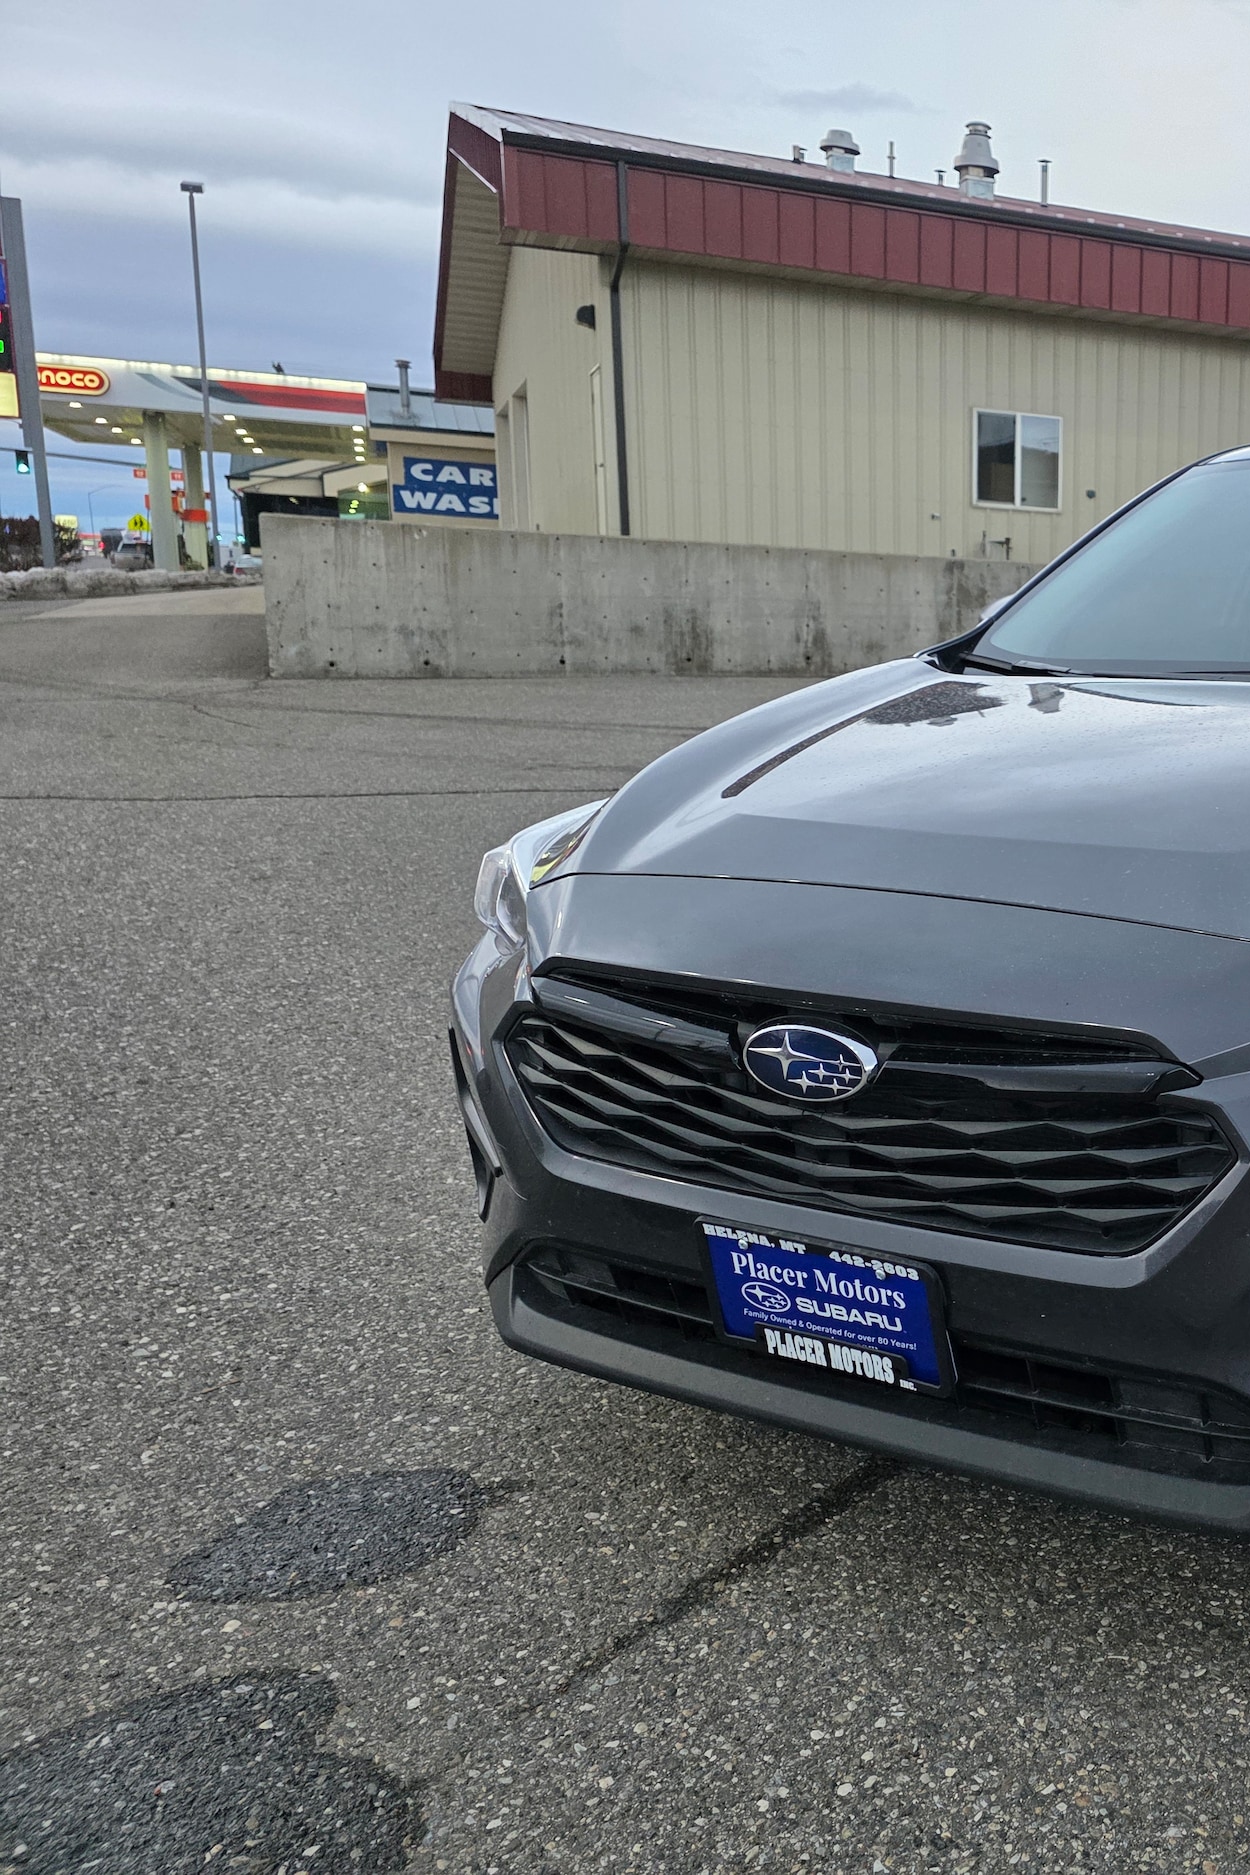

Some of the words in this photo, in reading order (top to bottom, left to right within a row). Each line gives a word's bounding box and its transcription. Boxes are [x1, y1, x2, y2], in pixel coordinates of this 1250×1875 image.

[410, 463, 495, 487] CAR
[779, 1239, 806, 1255] MT
[730, 1251, 808, 1289] Placer
[812, 1268, 906, 1310] Motors
[743, 1308, 769, 1321] Family
[769, 1314, 797, 1326] Owned
[798, 1320, 805, 1328] &
[805, 1321, 843, 1336] Operated
[843, 1329, 856, 1339] for
[857, 1333, 876, 1343] over
[877, 1336, 889, 1346] 80
[890, 1338, 918, 1351] Years!
[795, 1297, 903, 1332] SUBARU
[764, 1328, 827, 1367] PLACER
[827, 1342, 895, 1385] MOTORS
[899, 1378, 918, 1392] INC.
